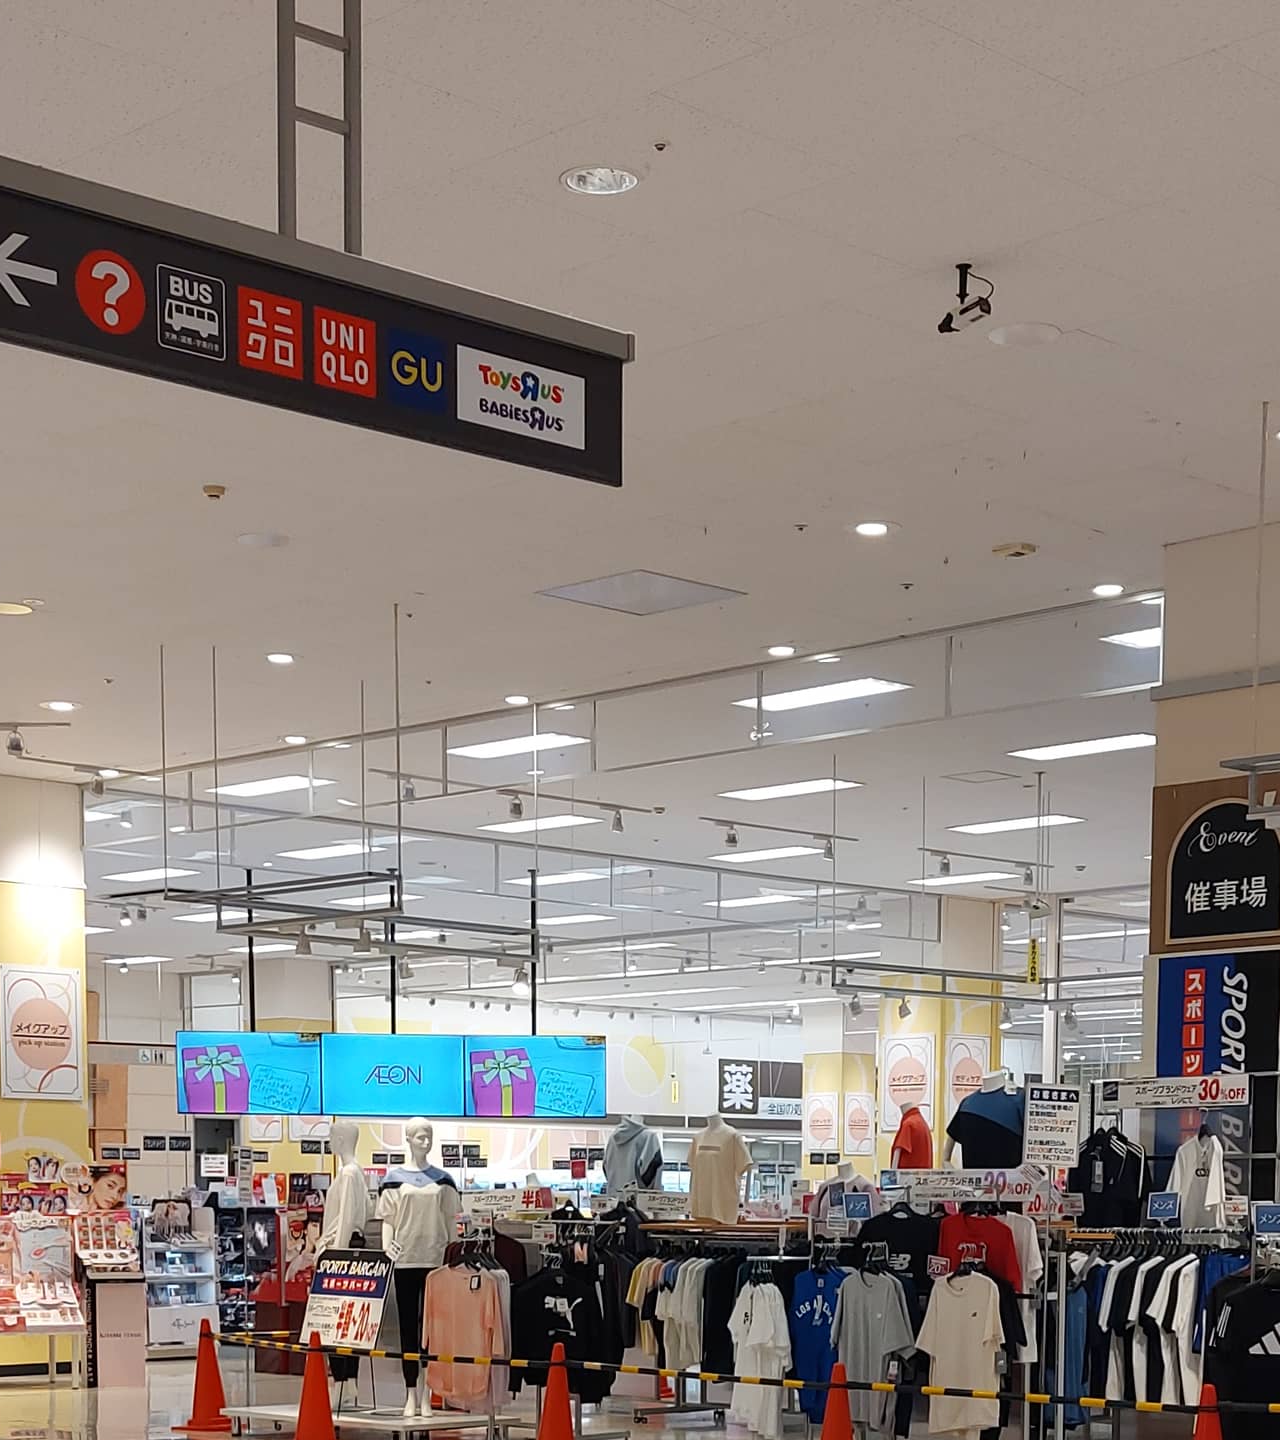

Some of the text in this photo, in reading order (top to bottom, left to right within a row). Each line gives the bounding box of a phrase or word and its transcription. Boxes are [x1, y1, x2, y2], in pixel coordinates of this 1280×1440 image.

[170, 275, 213, 304] BUS
[247, 299, 294, 335] ユニ
[246, 332, 294, 368] クロ
[321, 318, 365, 354] UNI
[321, 352, 369, 385] QLO
[391, 350, 443, 393] GU
[1187, 822, 1261, 857] Event
[1185, 876, 1268, 913] 催事場
[15, 1023, 67, 1035] メイクアップ
[1184, 971, 1203, 1074] スポーツ
[723, 1064, 754, 1110] 薬
[1152, 1199, 1174, 1211] メンズ
[317, 1260, 389, 1277] SPORTS BARGAIN
[795, 1301, 811, 1319] LOS
